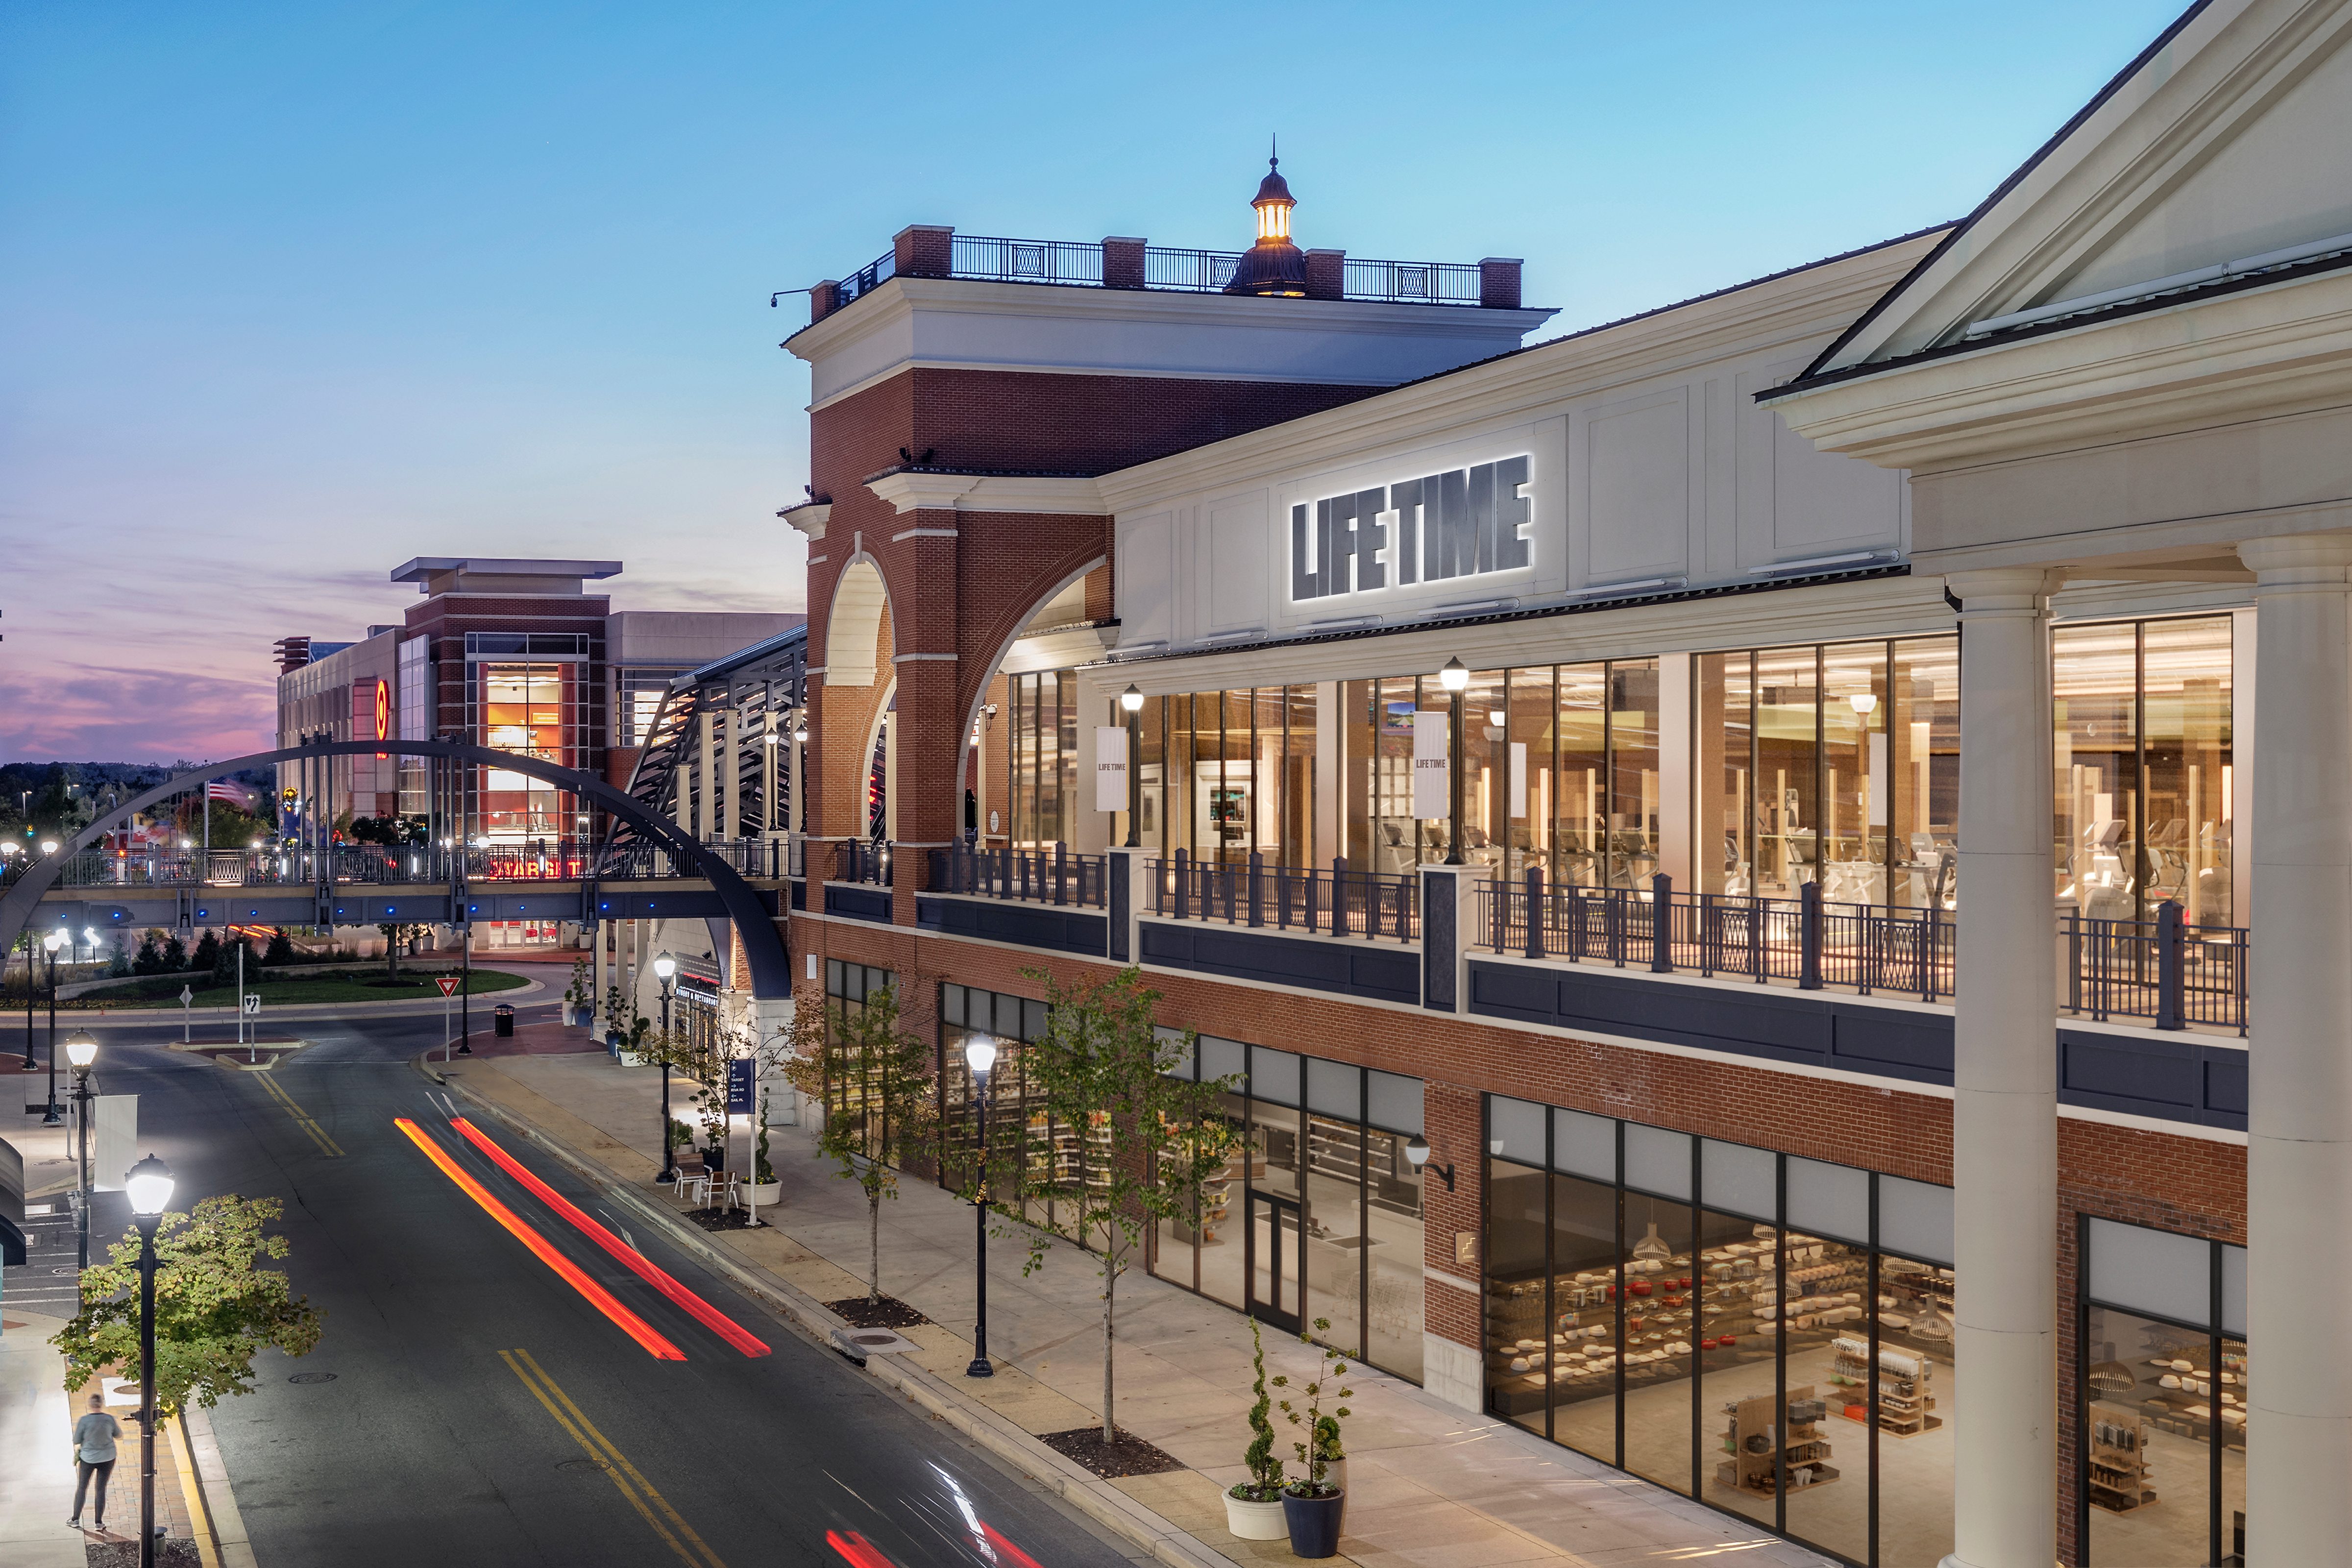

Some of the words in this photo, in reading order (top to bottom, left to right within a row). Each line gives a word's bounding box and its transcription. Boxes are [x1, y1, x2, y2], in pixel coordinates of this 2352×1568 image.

[1292, 486, 1387, 601] LIFE
[1391, 454, 1533, 586] TIME
[1417, 760, 1428, 768] LIFE
[1430, 760, 1445, 768] TIME
